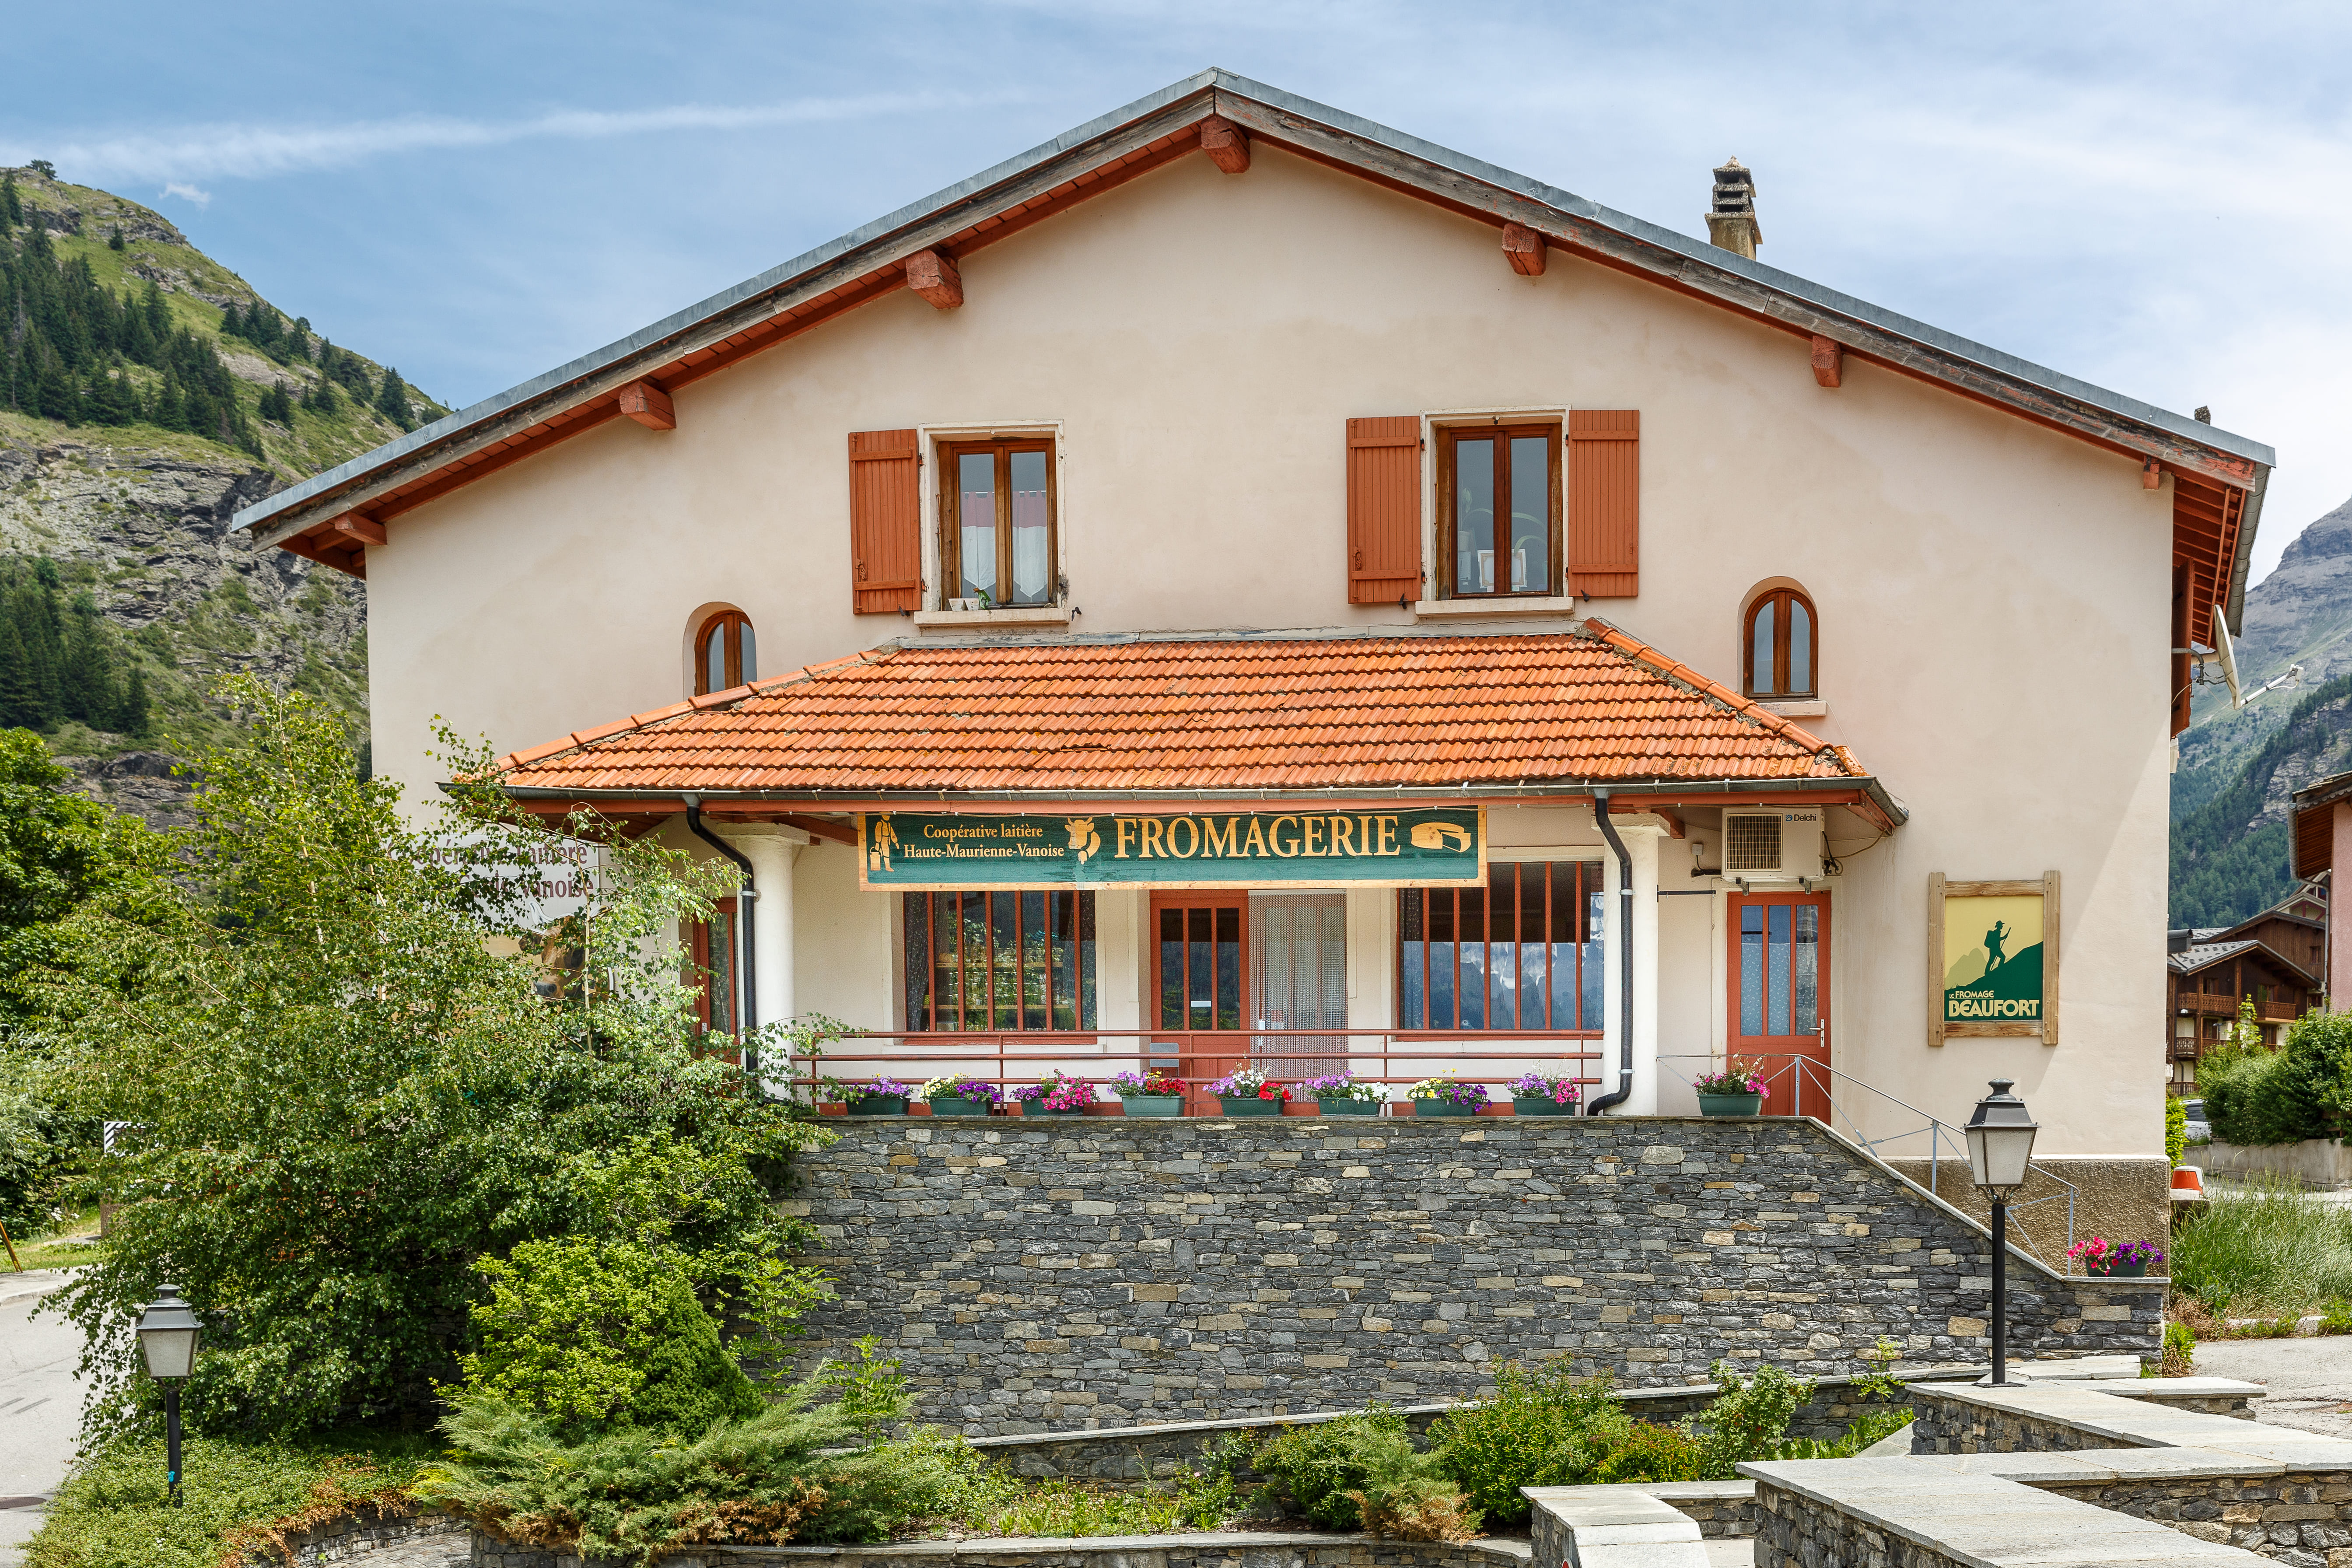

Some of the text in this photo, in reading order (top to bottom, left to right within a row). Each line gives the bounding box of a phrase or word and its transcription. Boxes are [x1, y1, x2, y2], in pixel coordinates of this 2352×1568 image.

[924, 823, 1043, 843] Coopérative laitière
[1114, 816, 1401, 859] FROMAGERIE
[904, 843, 1065, 858] Haute-Maurienne-Vanoise
[1955, 990, 1994, 999] FROMAGE
[1949, 999, 2040, 1018] BEAUFORT
